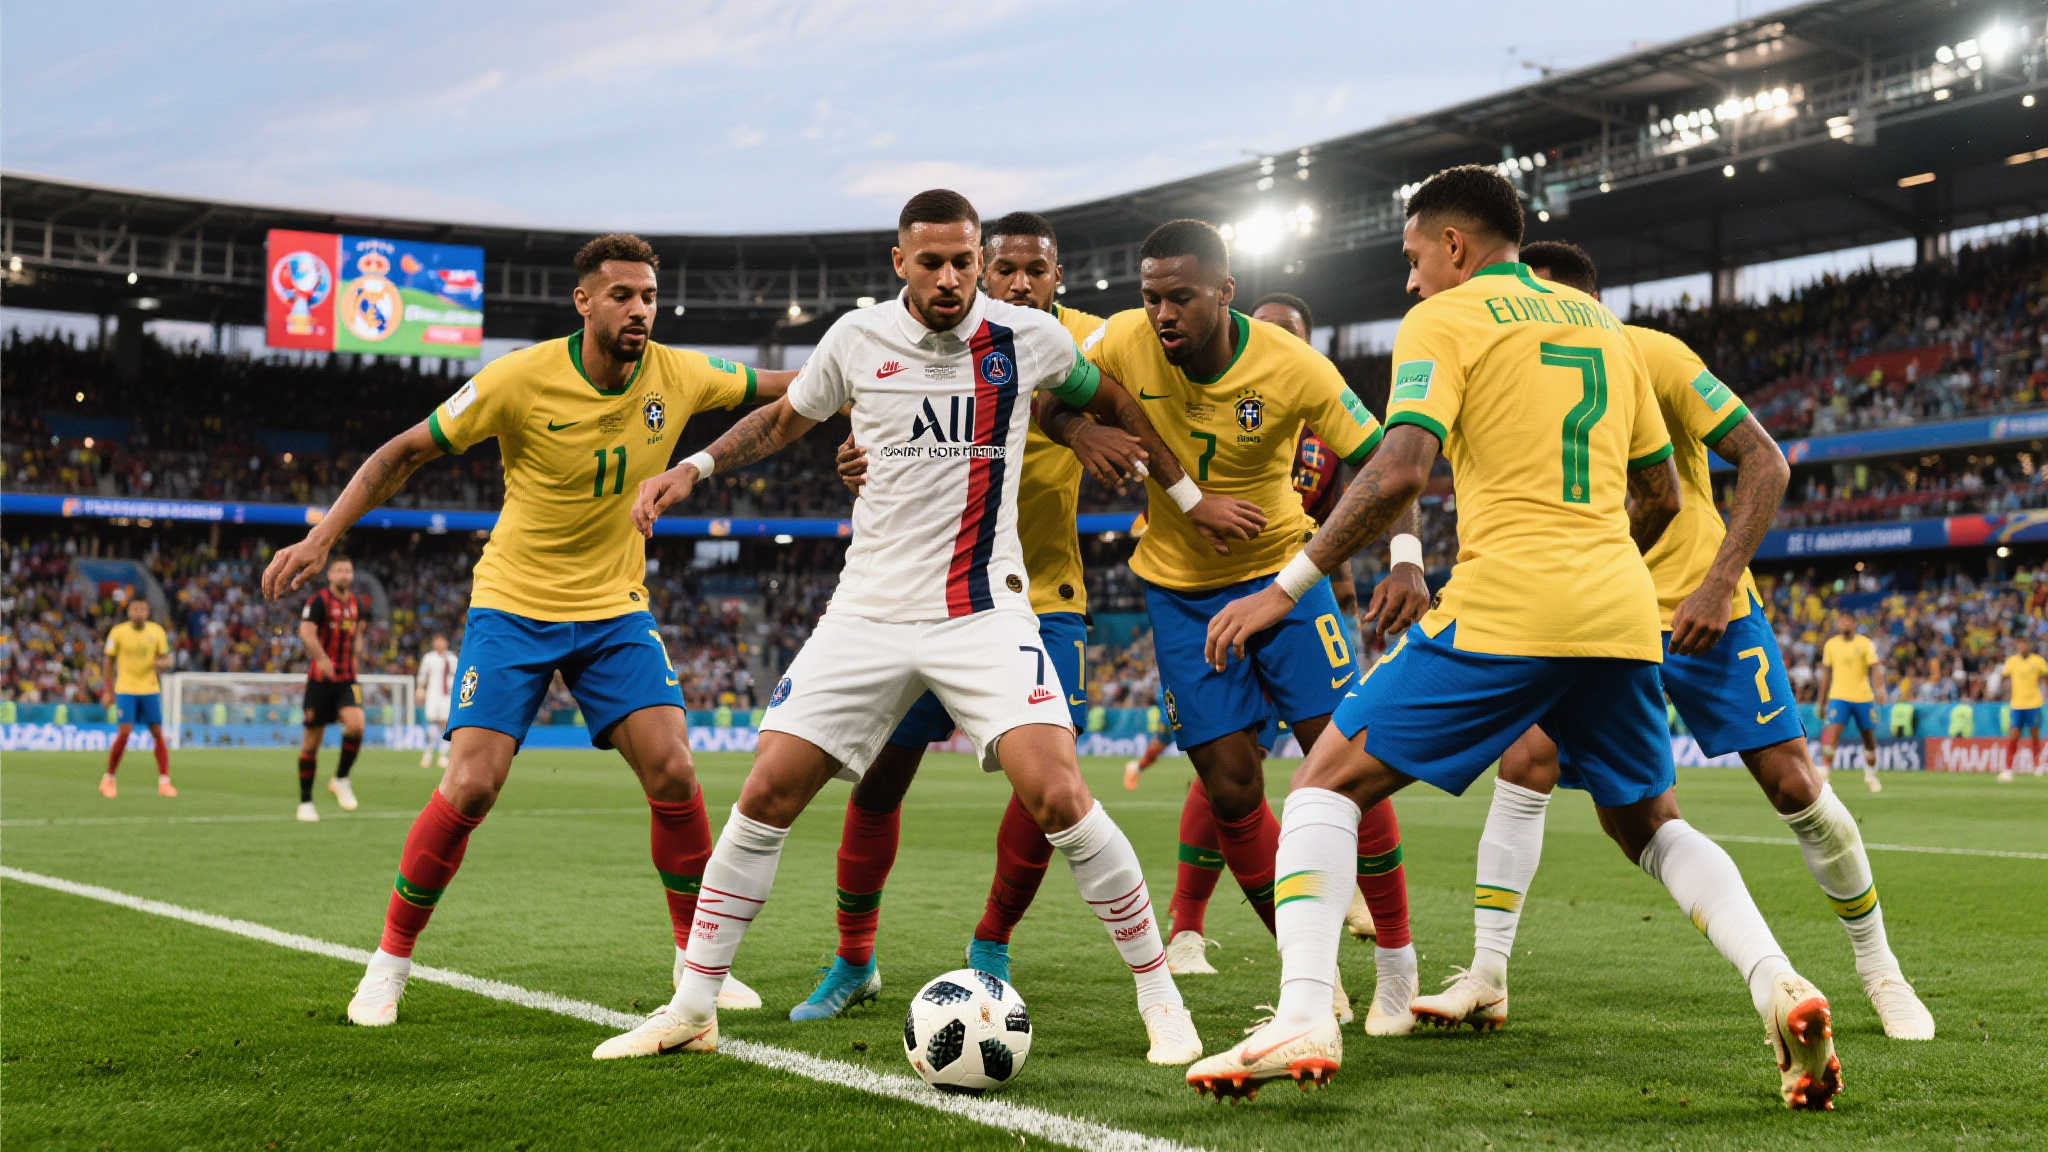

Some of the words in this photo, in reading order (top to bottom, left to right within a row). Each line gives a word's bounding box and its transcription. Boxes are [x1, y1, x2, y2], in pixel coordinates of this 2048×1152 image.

[1539, 341, 1608, 504] 7
[592, 445, 627, 498] 11
[1190, 430, 1217, 482] 7
[1019, 645, 1045, 685] 7
[1314, 613, 1351, 669] 8
[1737, 646, 1771, 704] 7
